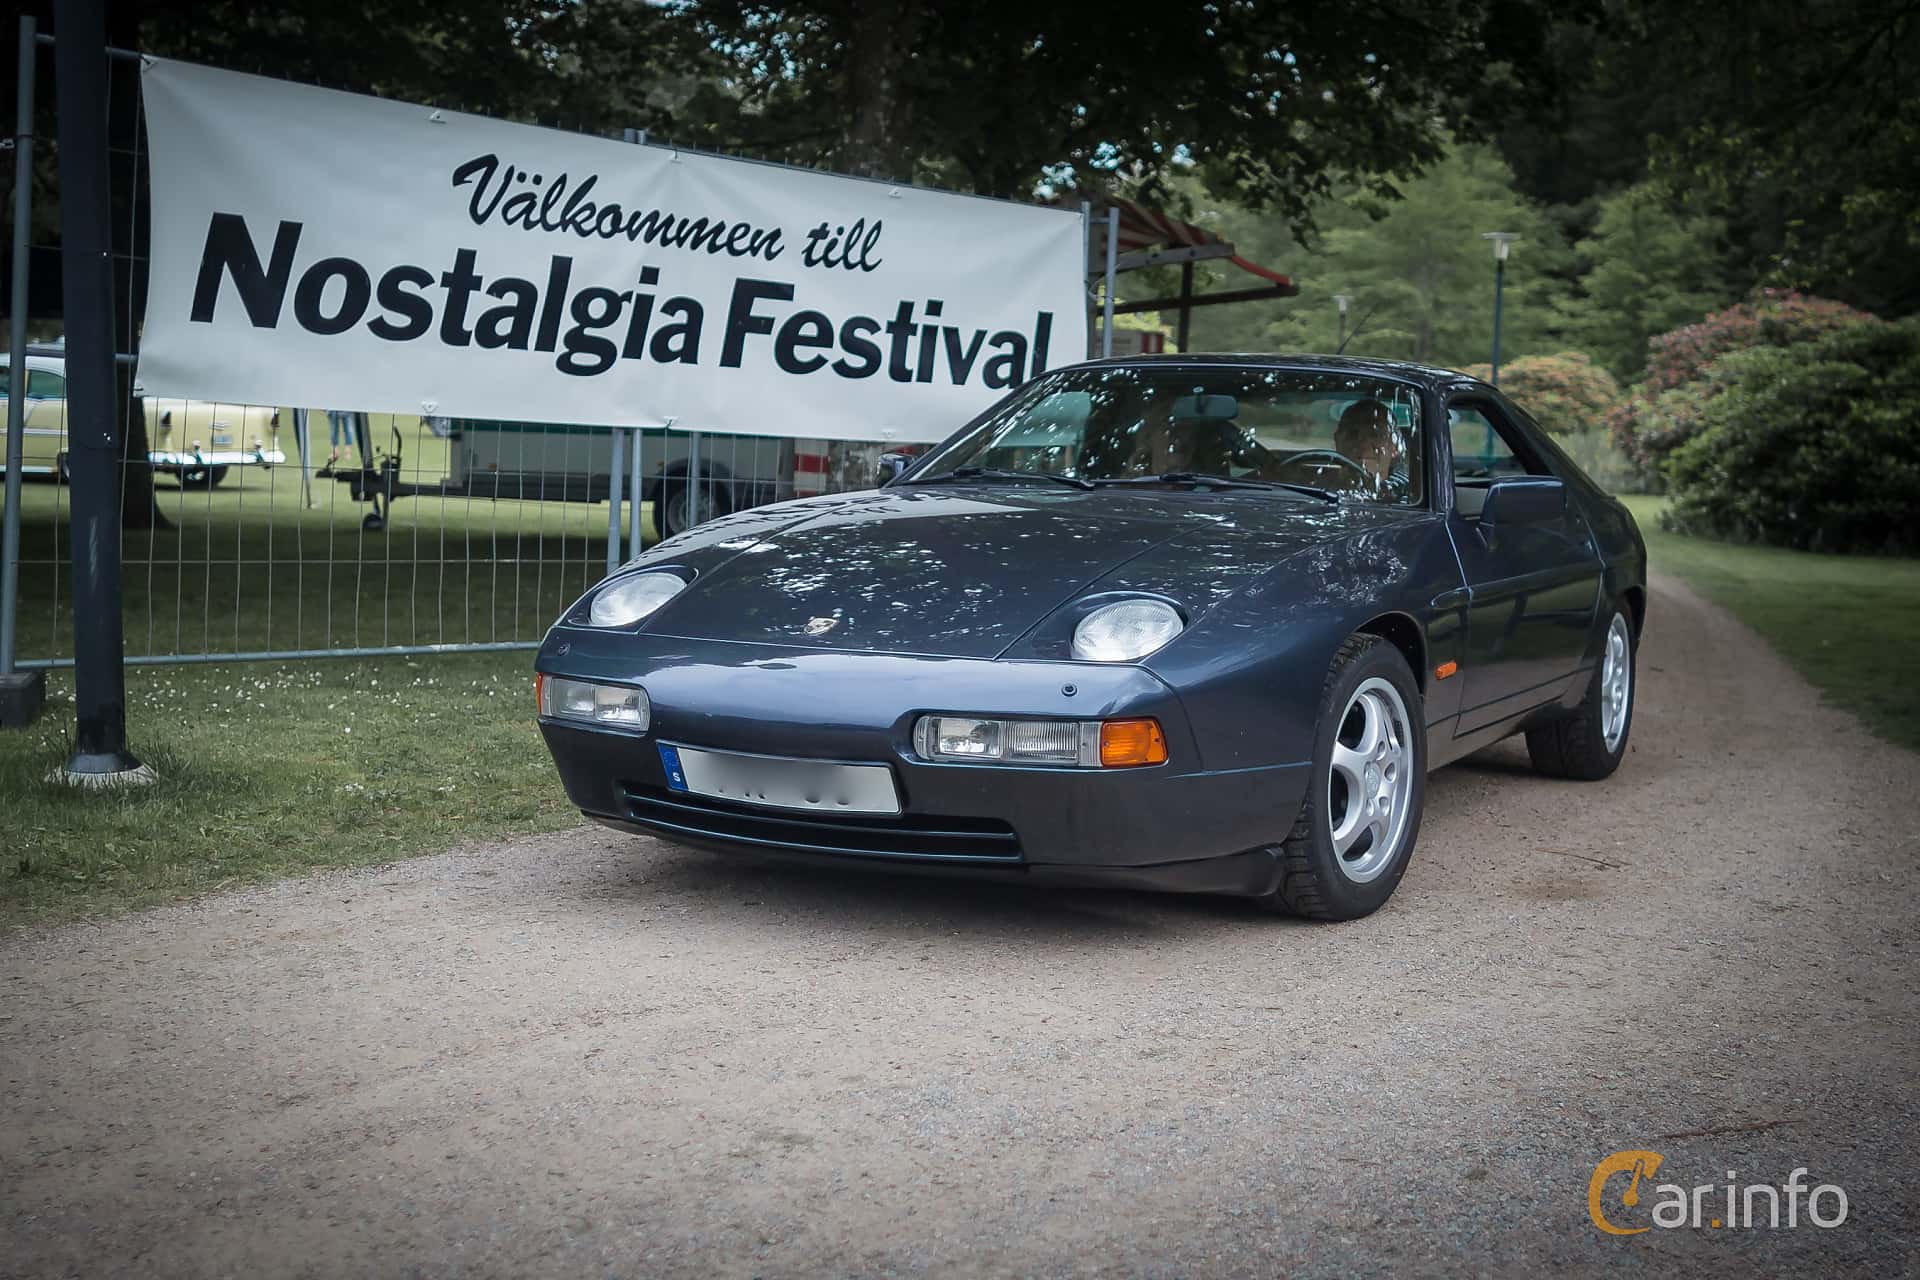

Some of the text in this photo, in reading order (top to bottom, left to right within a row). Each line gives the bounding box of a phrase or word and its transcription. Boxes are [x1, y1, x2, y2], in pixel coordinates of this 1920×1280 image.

[452, 153, 883, 272] Välkommen till
[189, 212, 1053, 390] Nostalgia Festival
[673, 772, 681, 782] S
